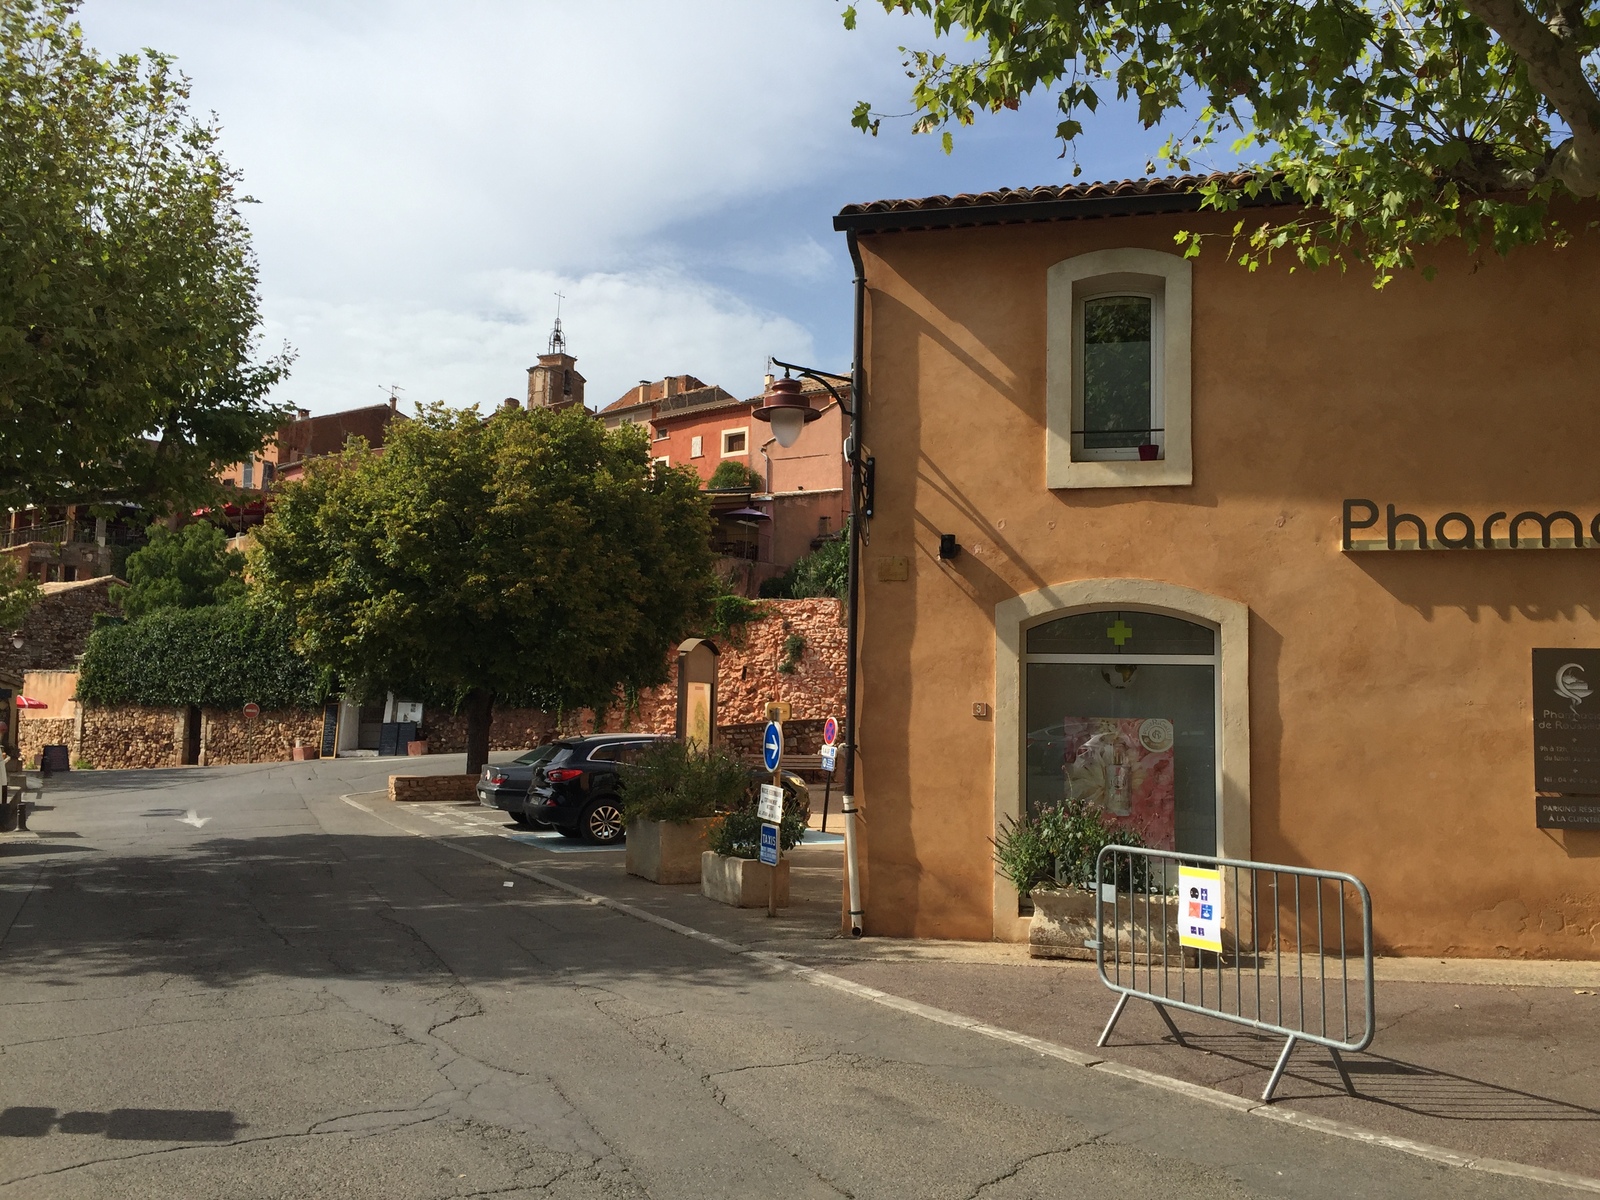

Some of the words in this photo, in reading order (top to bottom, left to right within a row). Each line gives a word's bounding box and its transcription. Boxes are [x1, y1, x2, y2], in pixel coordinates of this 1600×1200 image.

[1343, 499, 1600, 549] Pharm
[976, 705, 982, 713] 3
[1538, 721, 1552, 729] de
[1542, 804, 1577, 813] PARKING
[762, 833, 776, 846] TAXIS
